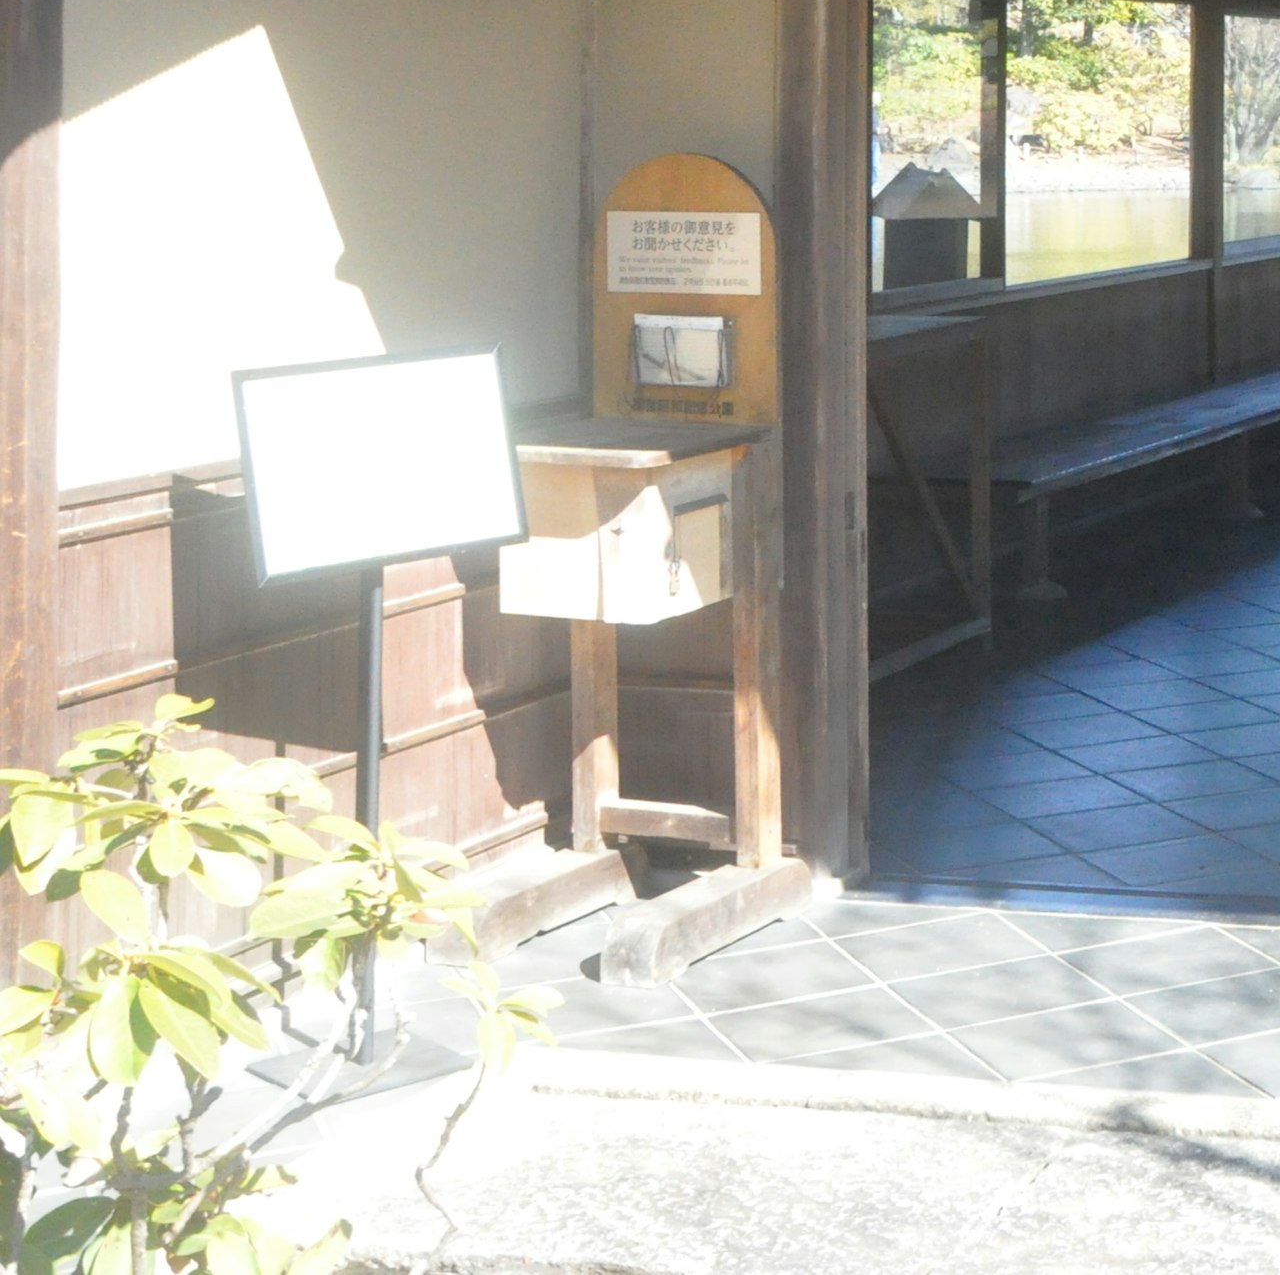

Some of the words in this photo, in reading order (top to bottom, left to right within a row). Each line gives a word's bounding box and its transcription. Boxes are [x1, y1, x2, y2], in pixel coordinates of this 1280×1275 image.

[631, 219, 737, 236] お客様の御意見を
